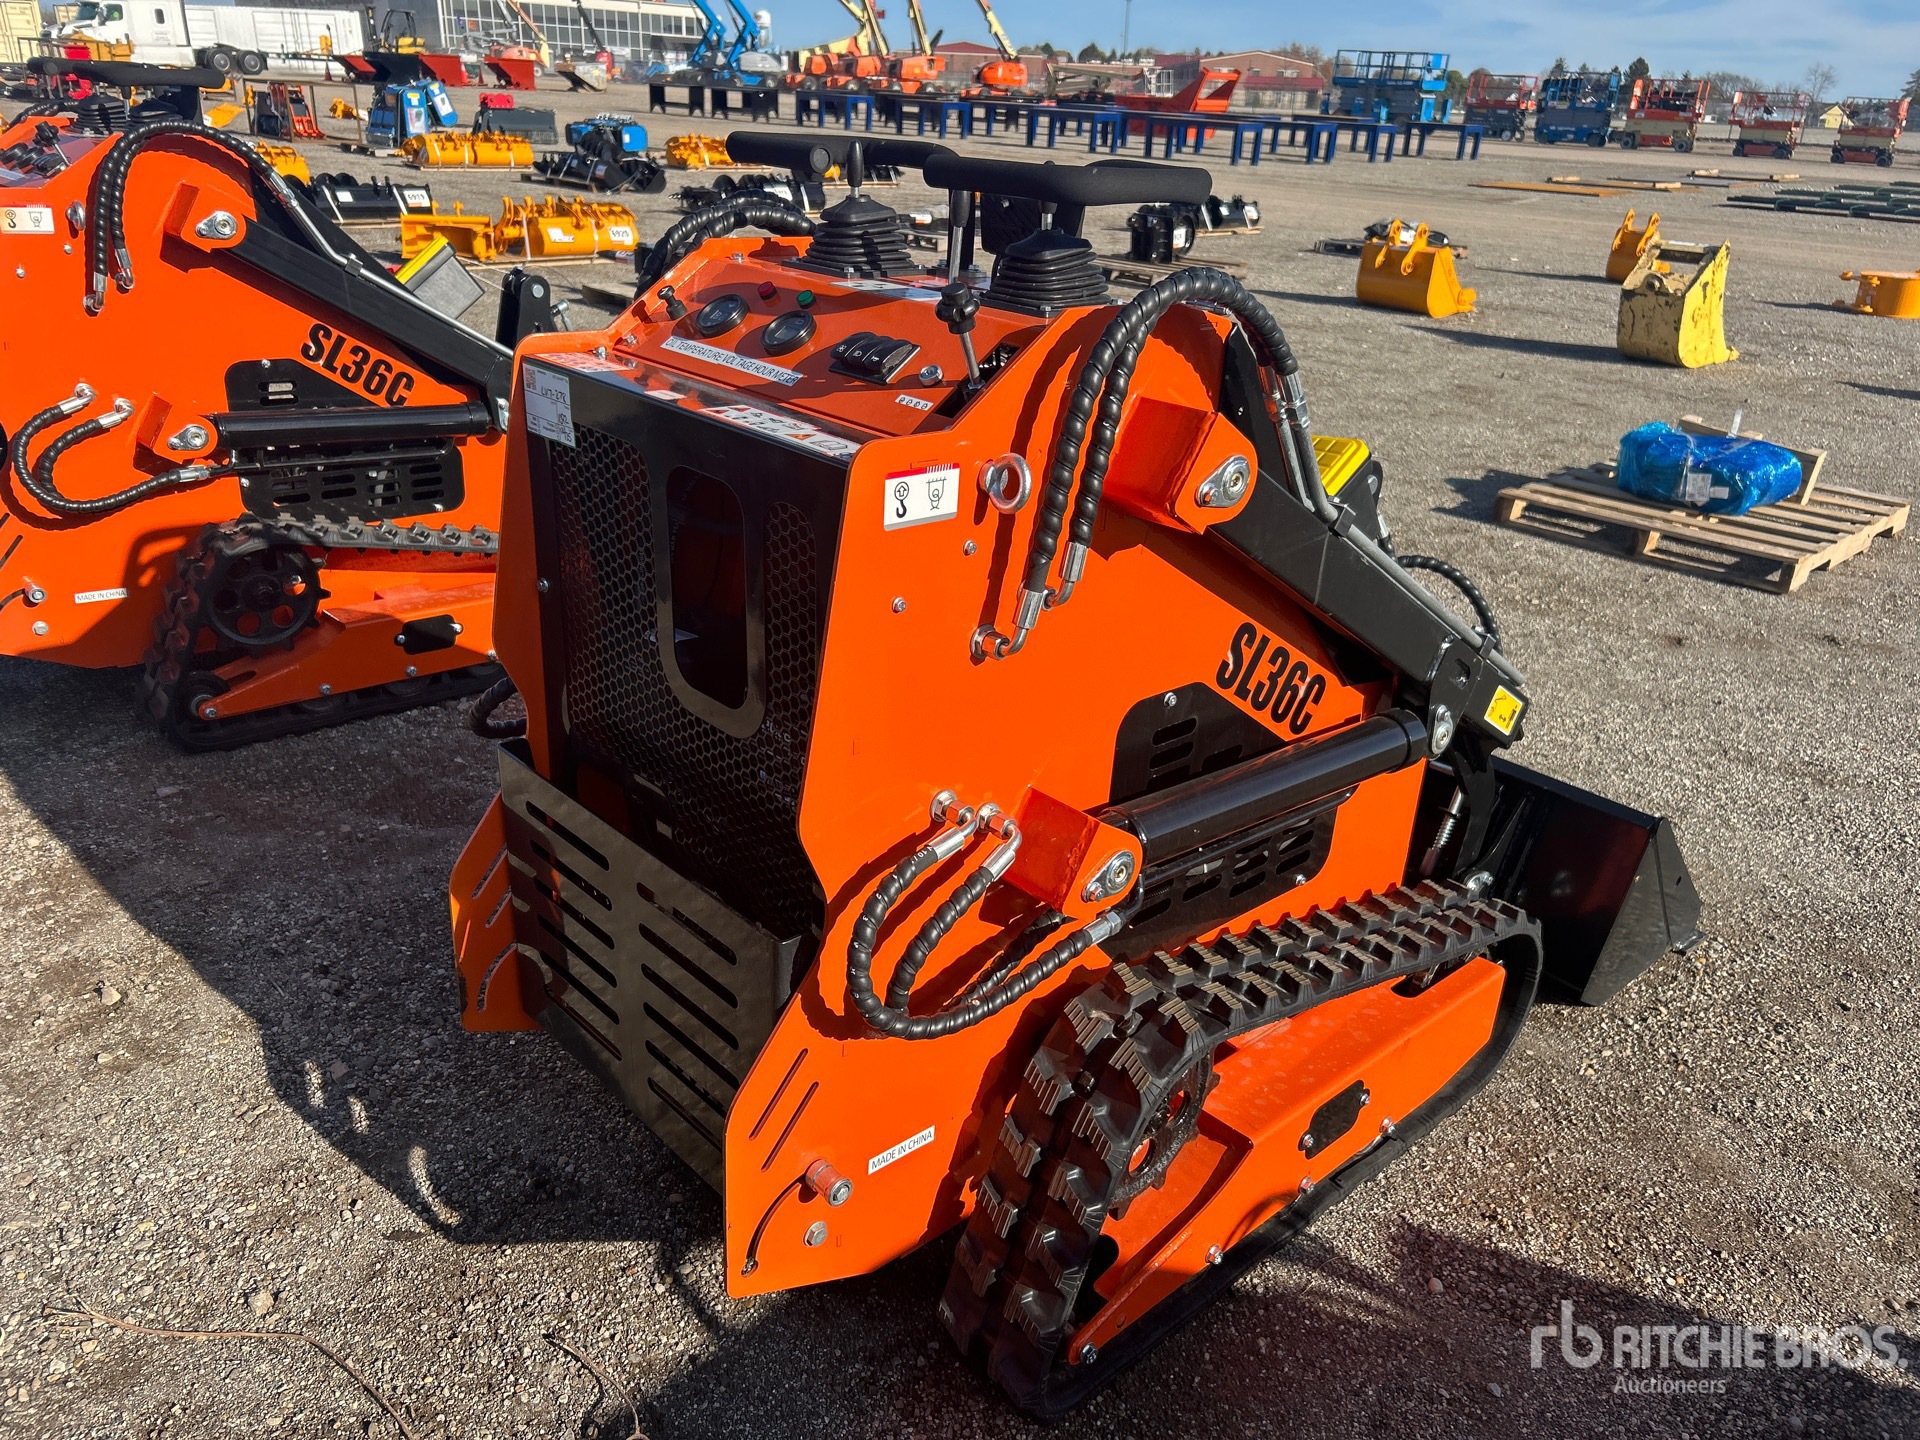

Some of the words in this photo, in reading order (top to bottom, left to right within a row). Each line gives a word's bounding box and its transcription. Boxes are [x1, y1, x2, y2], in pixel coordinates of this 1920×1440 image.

[301, 323, 415, 406] SL36C
[676, 341, 724, 364] TEMPERATURE
[722, 353, 754, 370] VOLTAGE
[752, 361, 774, 378] HOUR
[771, 368, 799, 384] METER
[77, 593, 96, 602] MADE
[106, 590, 126, 598] CHINA
[1214, 621, 1327, 736] SL36C
[871, 1149, 896, 1170] MADE
[898, 1144, 907, 1156] IN
[908, 1130, 932, 1150] CHINA
